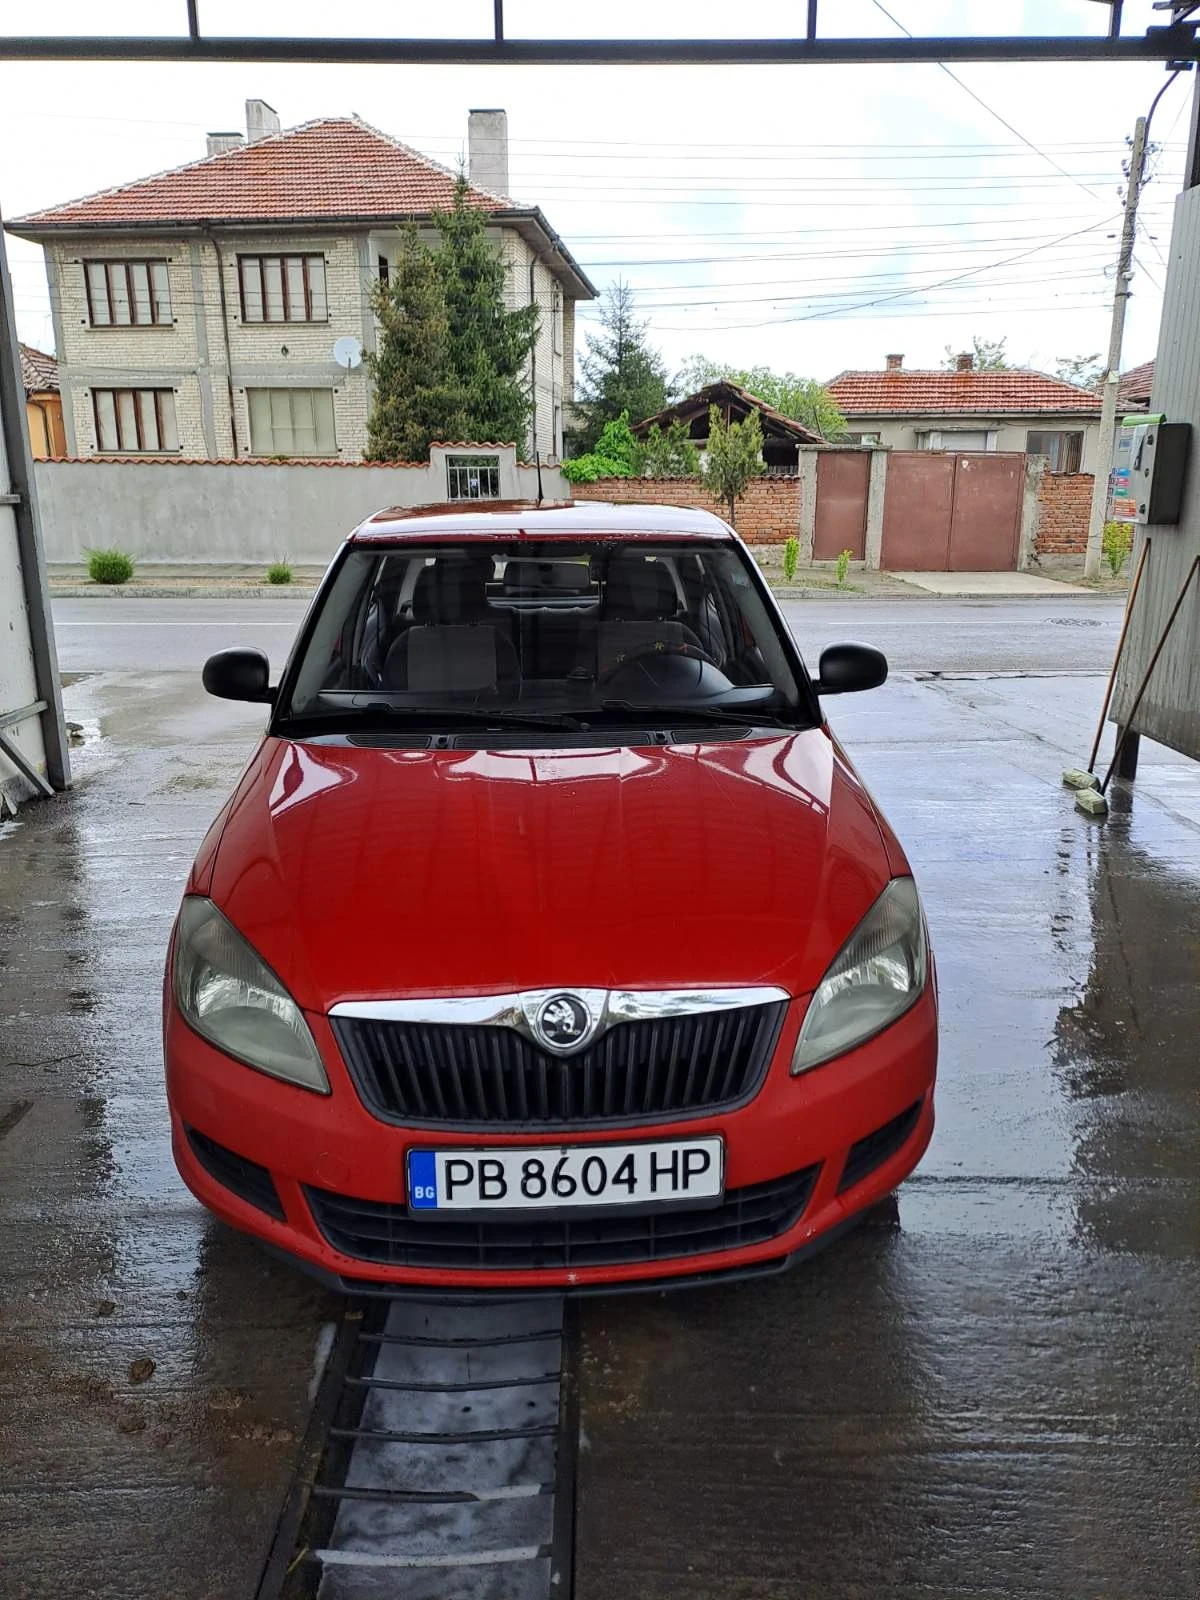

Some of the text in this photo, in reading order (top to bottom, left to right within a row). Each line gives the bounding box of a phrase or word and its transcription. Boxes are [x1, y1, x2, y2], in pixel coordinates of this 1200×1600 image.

[445, 1148, 711, 1200] PB 8604 HP
[414, 1186, 435, 1199] BG
